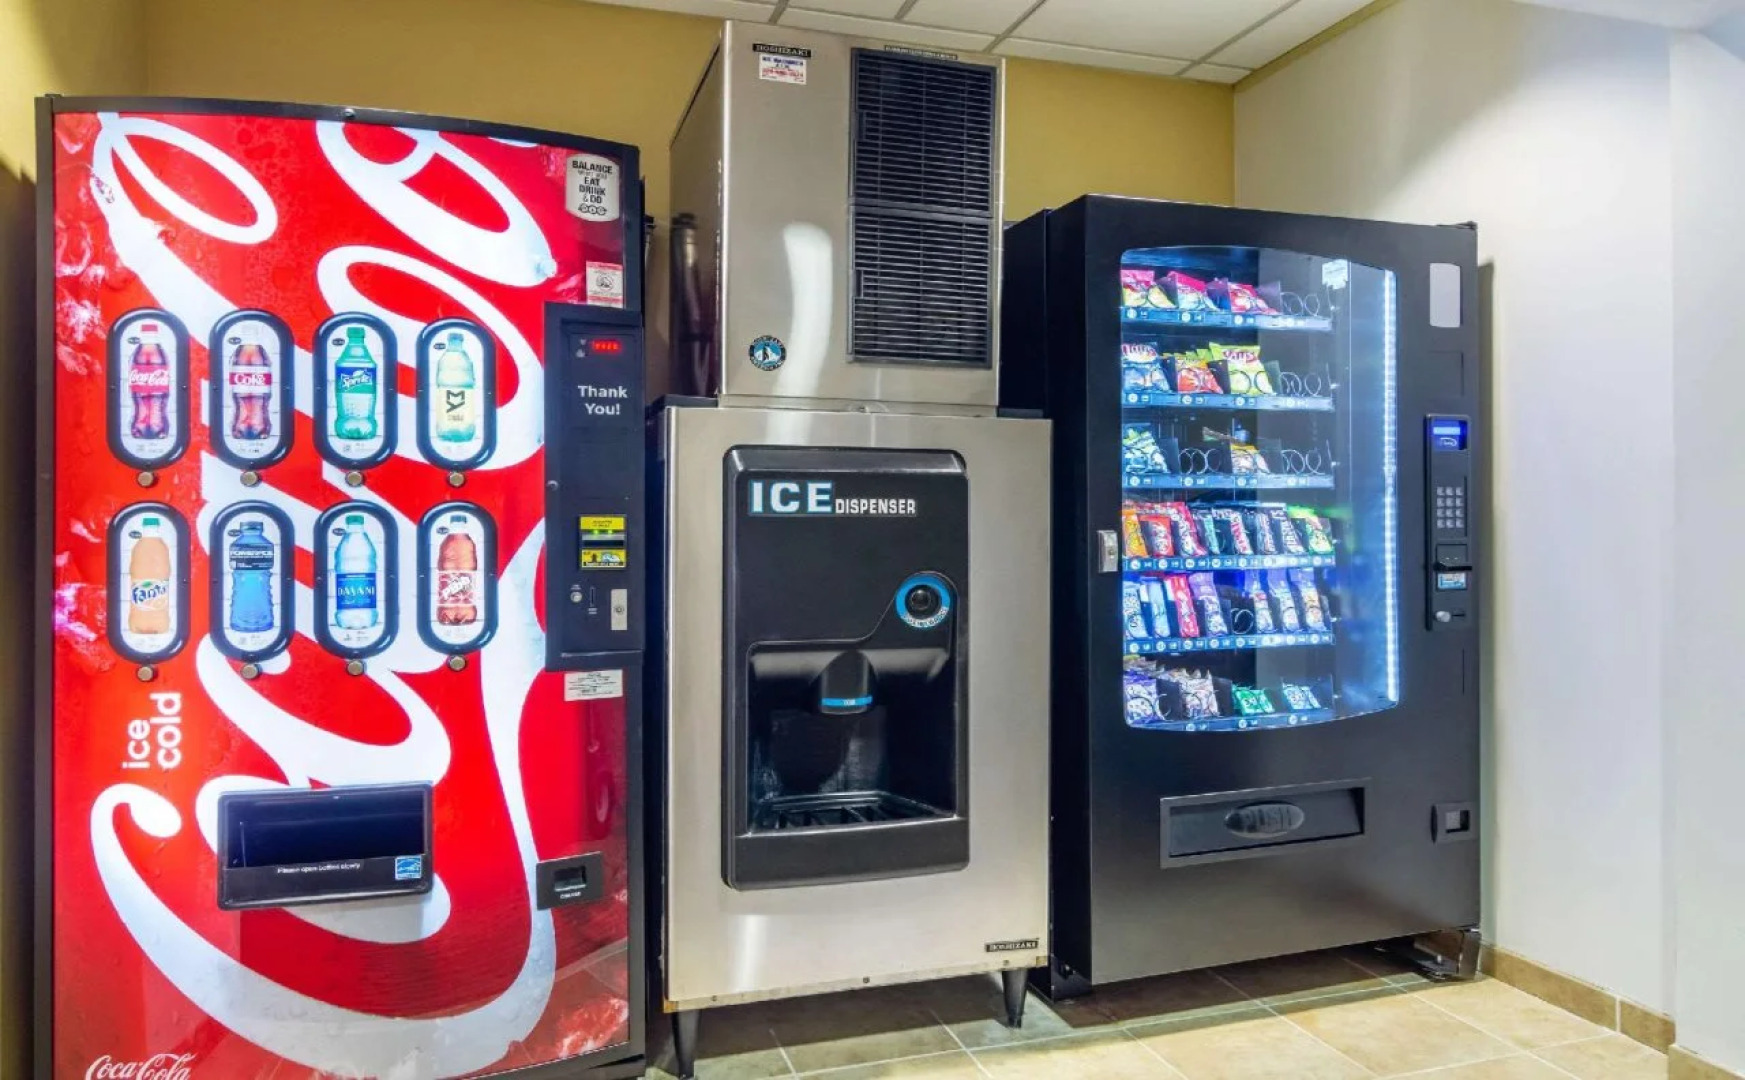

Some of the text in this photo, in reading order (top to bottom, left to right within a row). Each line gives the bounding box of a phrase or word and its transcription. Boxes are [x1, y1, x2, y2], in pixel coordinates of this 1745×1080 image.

[572, 160, 613, 174] BALANCE
[584, 177, 600, 187] EAT
[579, 184, 606, 196] DRINK
[233, 372, 266, 386] Coke
[578, 385, 628, 399] Thank
[585, 403, 621, 416] You!
[752, 481, 916, 515] ICE DISPENSER
[149, 691, 182, 770] cold
[121, 718, 151, 769] ice
[84, 1052, 198, 1080] Coca-Cola
